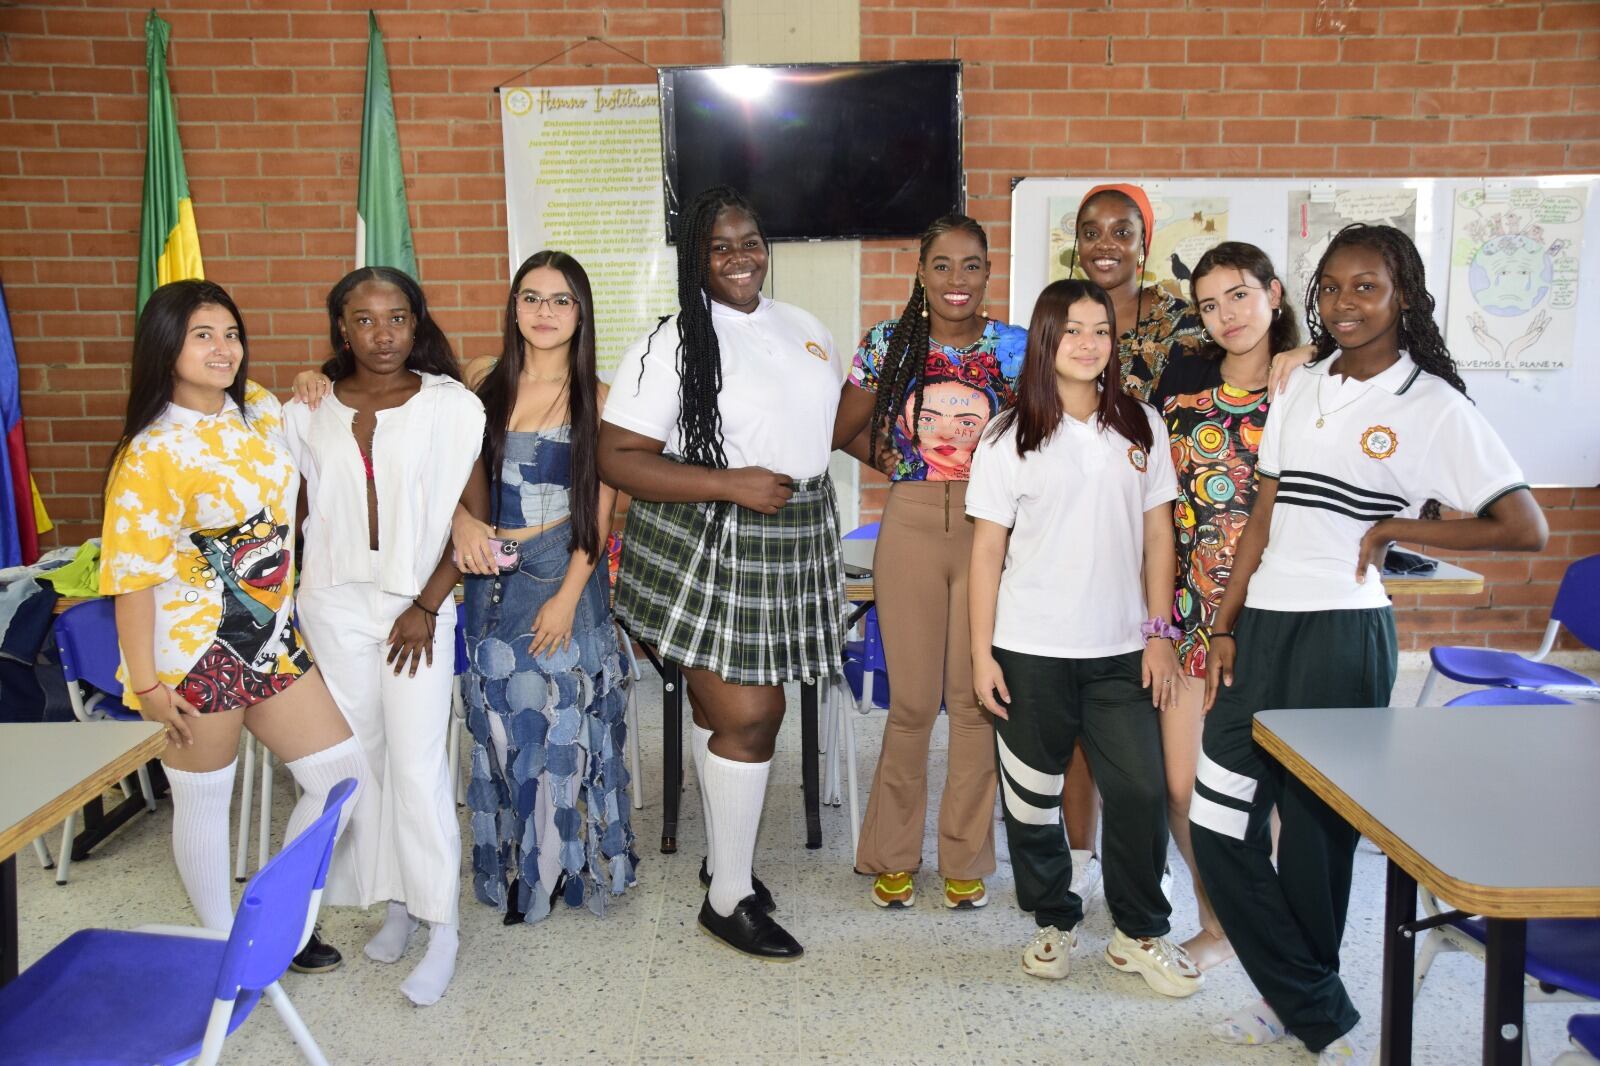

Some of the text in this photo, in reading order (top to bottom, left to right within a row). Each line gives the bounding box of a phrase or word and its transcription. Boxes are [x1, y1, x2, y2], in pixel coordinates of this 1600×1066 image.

[537, 87, 588, 114] Himno
[1455, 359, 1565, 369] ALVEMOS EL PLANETA
[954, 427, 975, 438] ART
